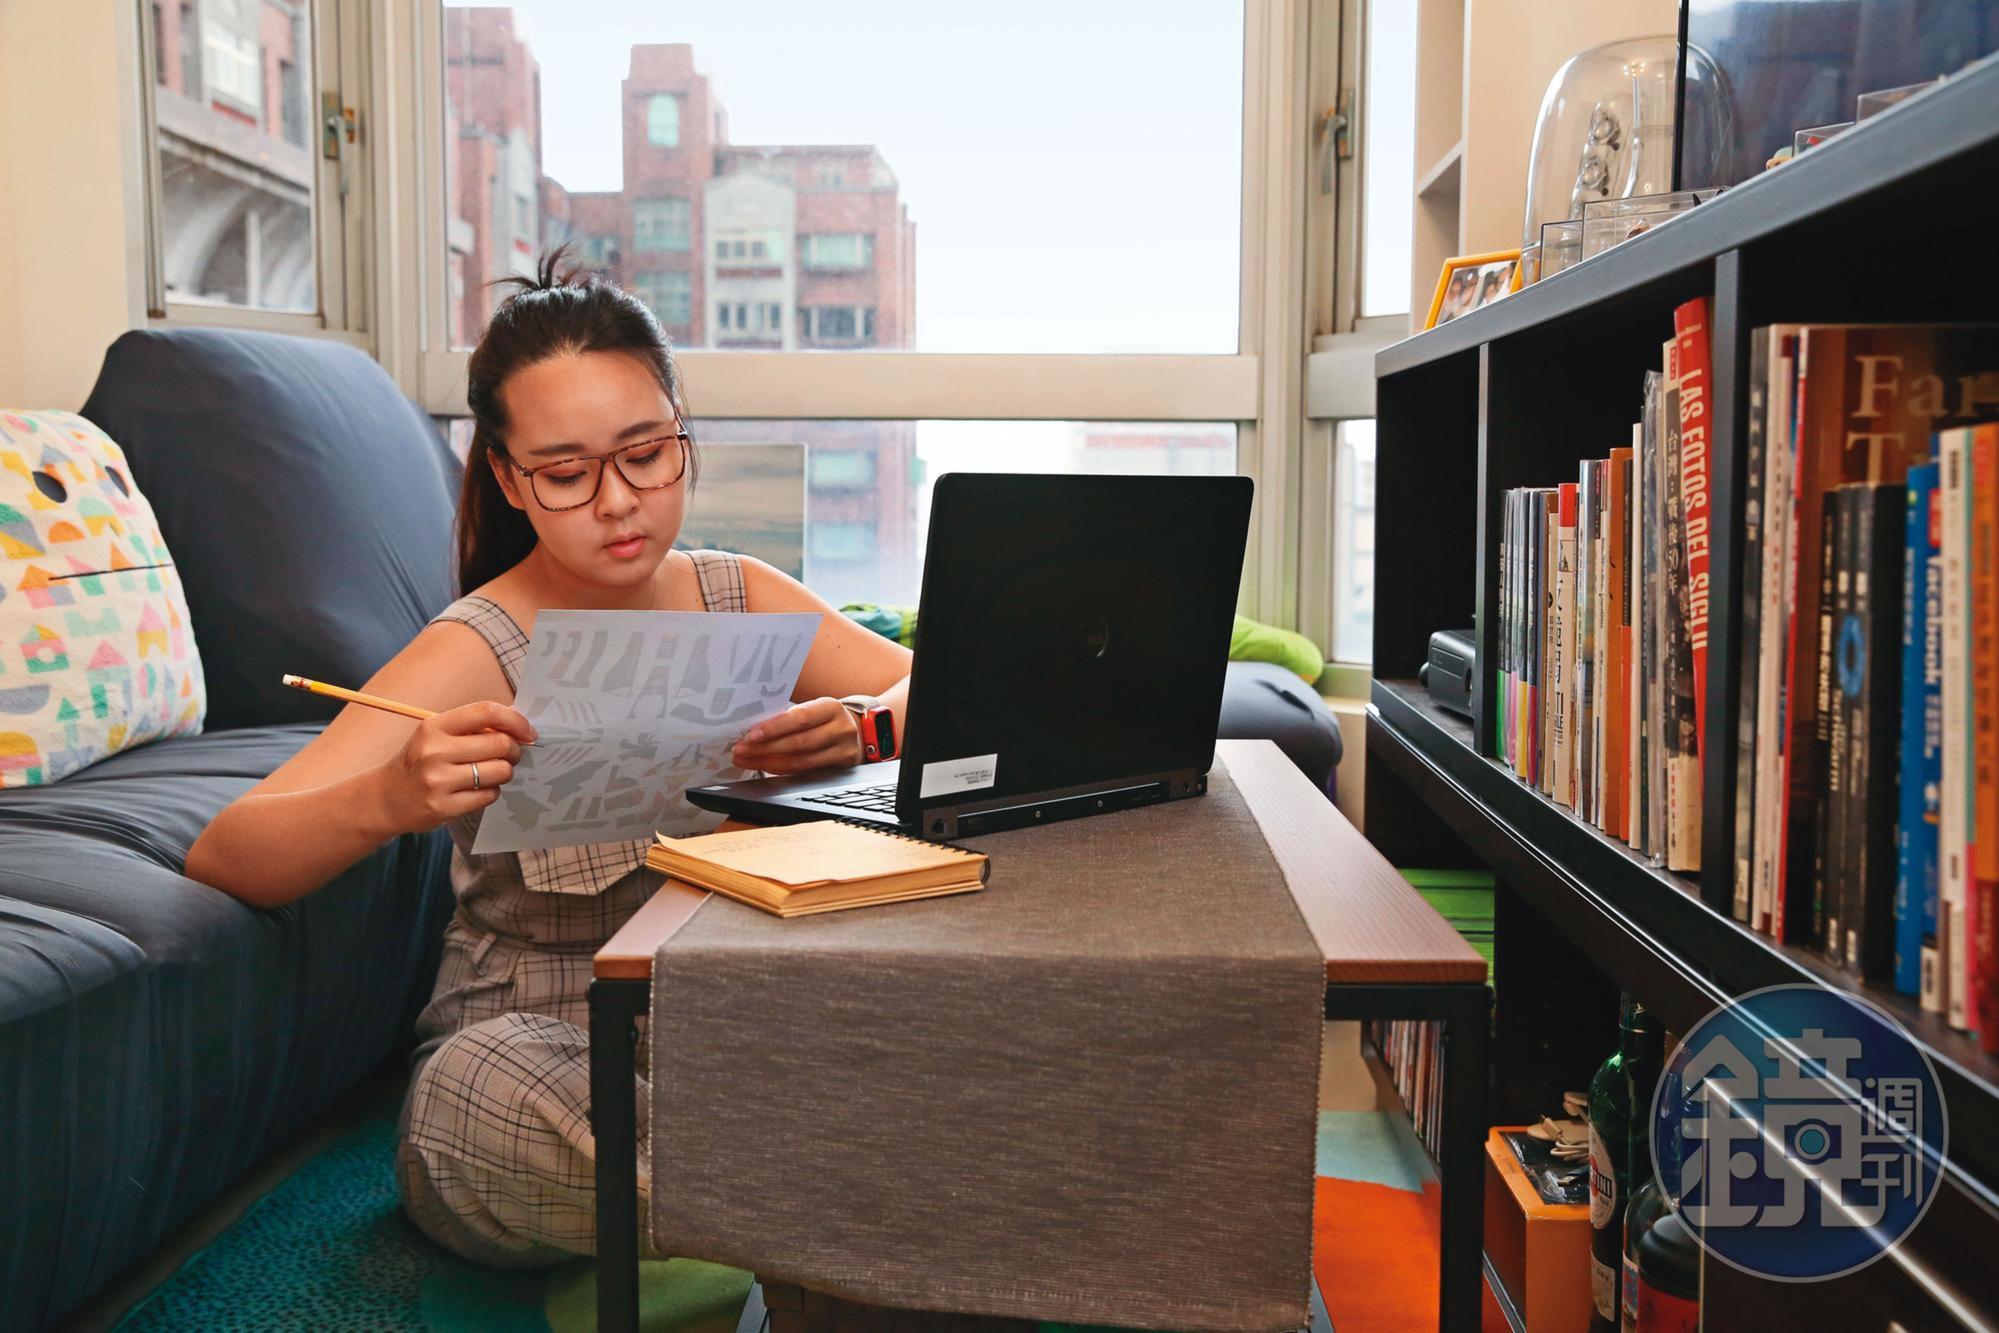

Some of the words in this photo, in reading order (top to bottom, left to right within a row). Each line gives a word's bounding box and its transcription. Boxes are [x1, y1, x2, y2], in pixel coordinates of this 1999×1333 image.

[1679, 367, 1705, 424] LAS
[1681, 424, 1708, 513] FOTOS
[1686, 516, 1709, 561] DEL
